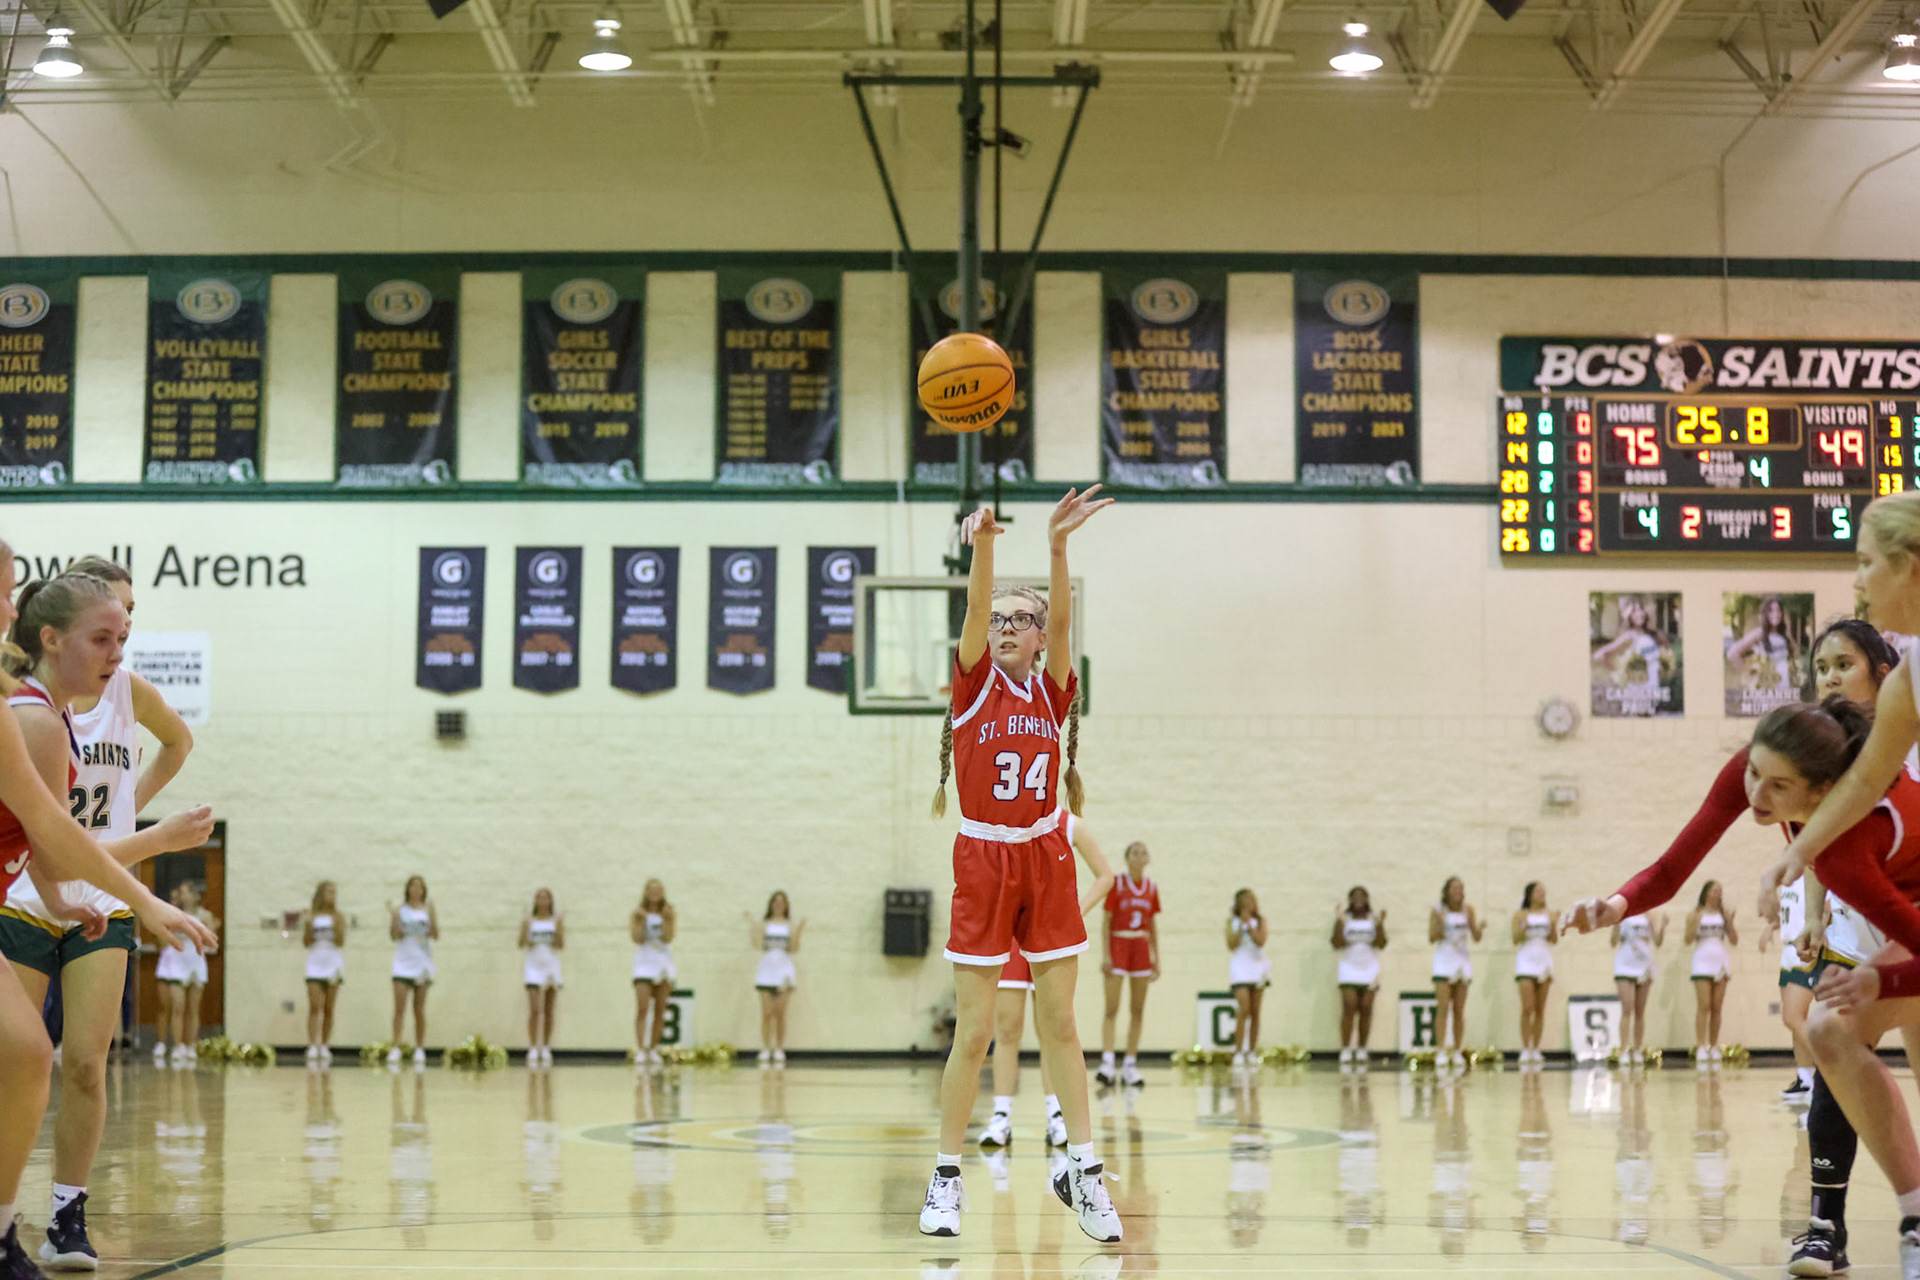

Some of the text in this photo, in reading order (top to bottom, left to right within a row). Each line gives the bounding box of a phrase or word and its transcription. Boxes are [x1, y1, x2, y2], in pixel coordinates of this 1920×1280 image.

[155, 339, 260, 359] VOLLEYBALL
[355, 330, 441, 349] FOOTBALL
[557, 330, 609, 349] GIRLS
[725, 329, 830, 349] BEST OF THE
[1139, 328, 1191, 347] GIRLS
[1334, 331, 1382, 351] BOYS
[182, 361, 231, 379] STATE
[372, 351, 422, 370] STATE
[548, 351, 618, 370] SOCCER
[752, 351, 809, 370] PREPS
[1111, 350, 1220, 370] BASKETBALL
[1312, 352, 1402, 371] LACROSSE
[1534, 344, 1920, 389] BCS SAINTS
[153, 381, 259, 400] CHAMPIONS
[343, 373, 451, 392] CHAMPIONS
[557, 372, 608, 391] STATE
[1140, 371, 1191, 390] STATE
[1332, 372, 1383, 391] STATE
[528, 392, 637, 413] CHAMPIONS
[938, 401, 1002, 425] Wilson
[1110, 392, 1220, 412] CHAMPIONS
[1302, 392, 1413, 412] CHAMPIONS
[1606, 403, 1656, 423] HOME
[1879, 399, 1898, 415] NO
[1506, 411, 1592, 436] 12 0 0
[1676, 406, 1770, 444] 25.8
[1803, 405, 1868, 425] VISITOR
[1889, 415, 1902, 438] 3
[1507, 440, 1529, 464] 14
[1576, 440, 1592, 465] 0
[1613, 426, 1661, 467] 75
[1818, 429, 1865, 468] 49
[1883, 444, 1903, 467] 15
[1625, 469, 1668, 486] BONUS
[1699, 461, 1745, 478] PERIOD
[1749, 455, 1770, 489] 4
[1803, 470, 1845, 487] BONUS
[1501, 469, 1593, 494] 20 2 3
[1878, 472, 1904, 496] 33
[1501, 498, 1593, 523] 22 1 5
[1619, 491, 1660, 507] FOULS
[1813, 493, 1852, 509] FOULS
[1637, 505, 1660, 539] 4
[1681, 505, 1702, 540] 2
[1705, 509, 1767, 526] TIMEOUTS
[1772, 506, 1792, 540] 3
[1831, 507, 1852, 540] 5
[1502, 528, 1594, 553] 25 0 2
[1721, 524, 1751, 539] LEFT
[153, 545, 306, 588] Arena
[440, 559, 462, 583] G
[536, 558, 559, 583] G
[633, 558, 656, 583] G
[731, 558, 753, 583] G
[829, 558, 852, 582] G
[978, 720, 1001, 745] ST.
[82, 741, 131, 771] SAINTS
[991, 750, 1051, 802] 34
[68, 783, 110, 831] 22
[1212, 1004, 1236, 1047] C
[1411, 1005, 1438, 1047] H
[1584, 1007, 1609, 1049] S
